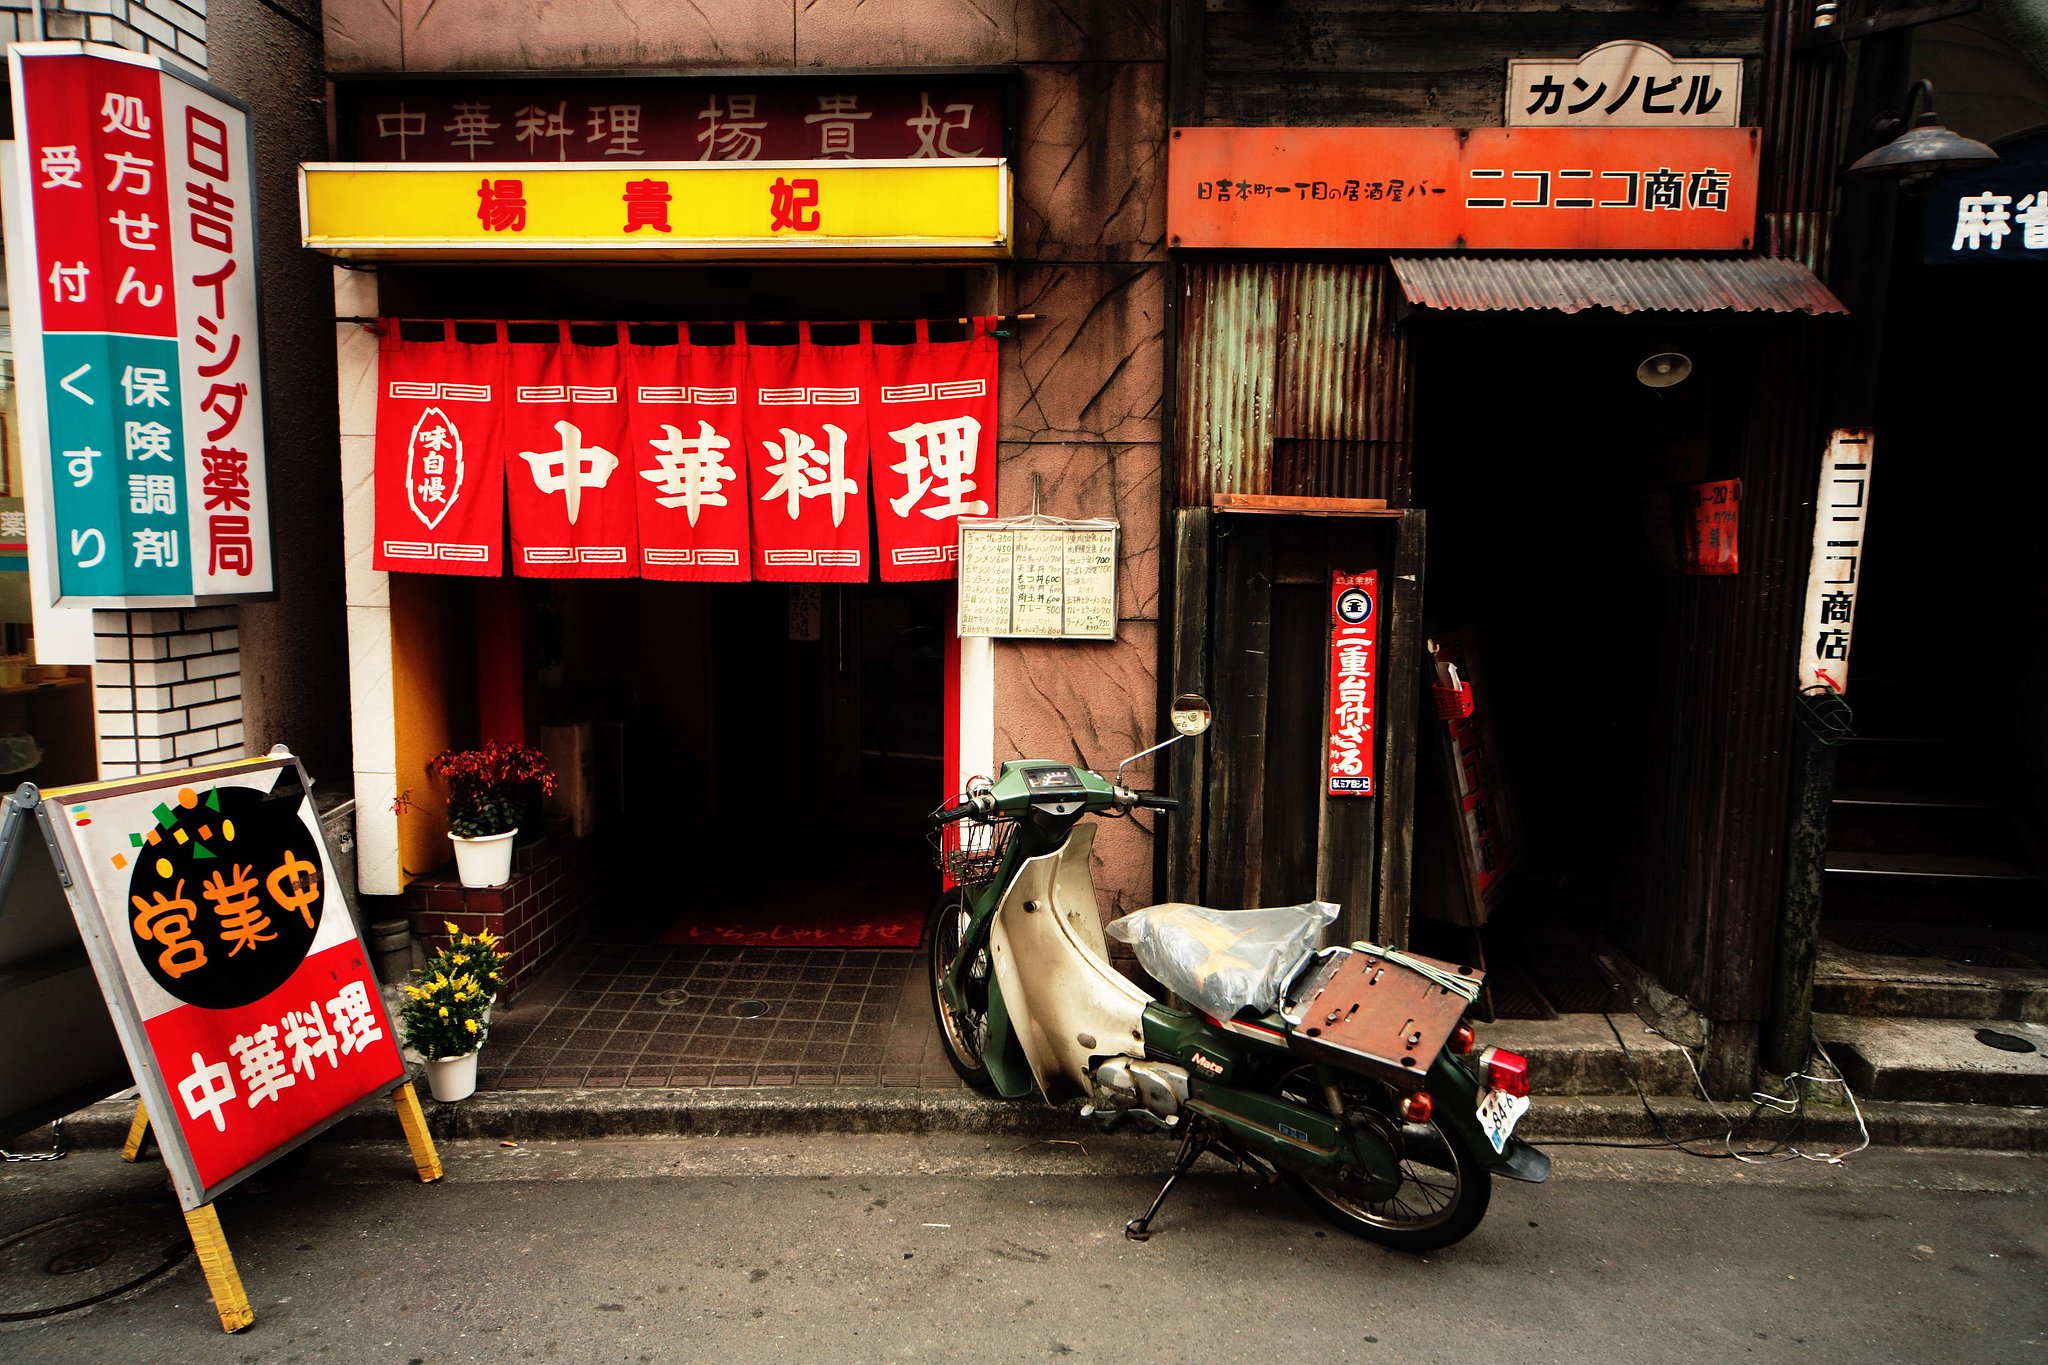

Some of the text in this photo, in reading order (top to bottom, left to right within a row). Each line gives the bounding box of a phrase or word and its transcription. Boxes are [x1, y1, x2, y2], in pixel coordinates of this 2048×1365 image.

[1525, 73, 1724, 117] カンノビル
[376, 100, 647, 162] 中華料理
[101, 92, 164, 309] 処方せん
[476, 177, 821, 233] 楊貴妃
[1197, 166, 1733, 213] 日吉本町一丁目の居酒屋バー ニコニコ商店
[40, 145, 91, 304] 受付
[185, 105, 253, 577] 日吉イシダ薬局
[60, 363, 107, 569] くすり
[121, 366, 180, 569] 保険調剤
[417, 424, 453, 505] 味自慢
[518, 414, 990, 529] 中華料理
[967, 544, 1012, 553] ラーメン 450
[967, 554, 1009, 564] タンメン 600
[996, 565, 1010, 574] 600
[1095, 556, 1110, 564] 700
[1815, 438, 1868, 662] ニコニコ商店
[995, 586, 1009, 595] 650
[996, 576, 1009, 585] 600
[1018, 575, 1044, 585] もつ丼
[1045, 575, 1061, 585] 600
[1018, 593, 1060, 604] 肉玉丼 600
[994, 625, 1007, 634] 700
[995, 606, 1009, 615] 650
[1046, 606, 1060, 614] 500
[1098, 618, 1110, 627] 750
[1335, 626, 1373, 776] 二重台付ざる
[132, 849, 323, 979] 営業中
[687, 922, 906, 940] いらっしゃいませ
[177, 980, 384, 1133] 中華料理
[1191, 1052, 1224, 1075] Mate
